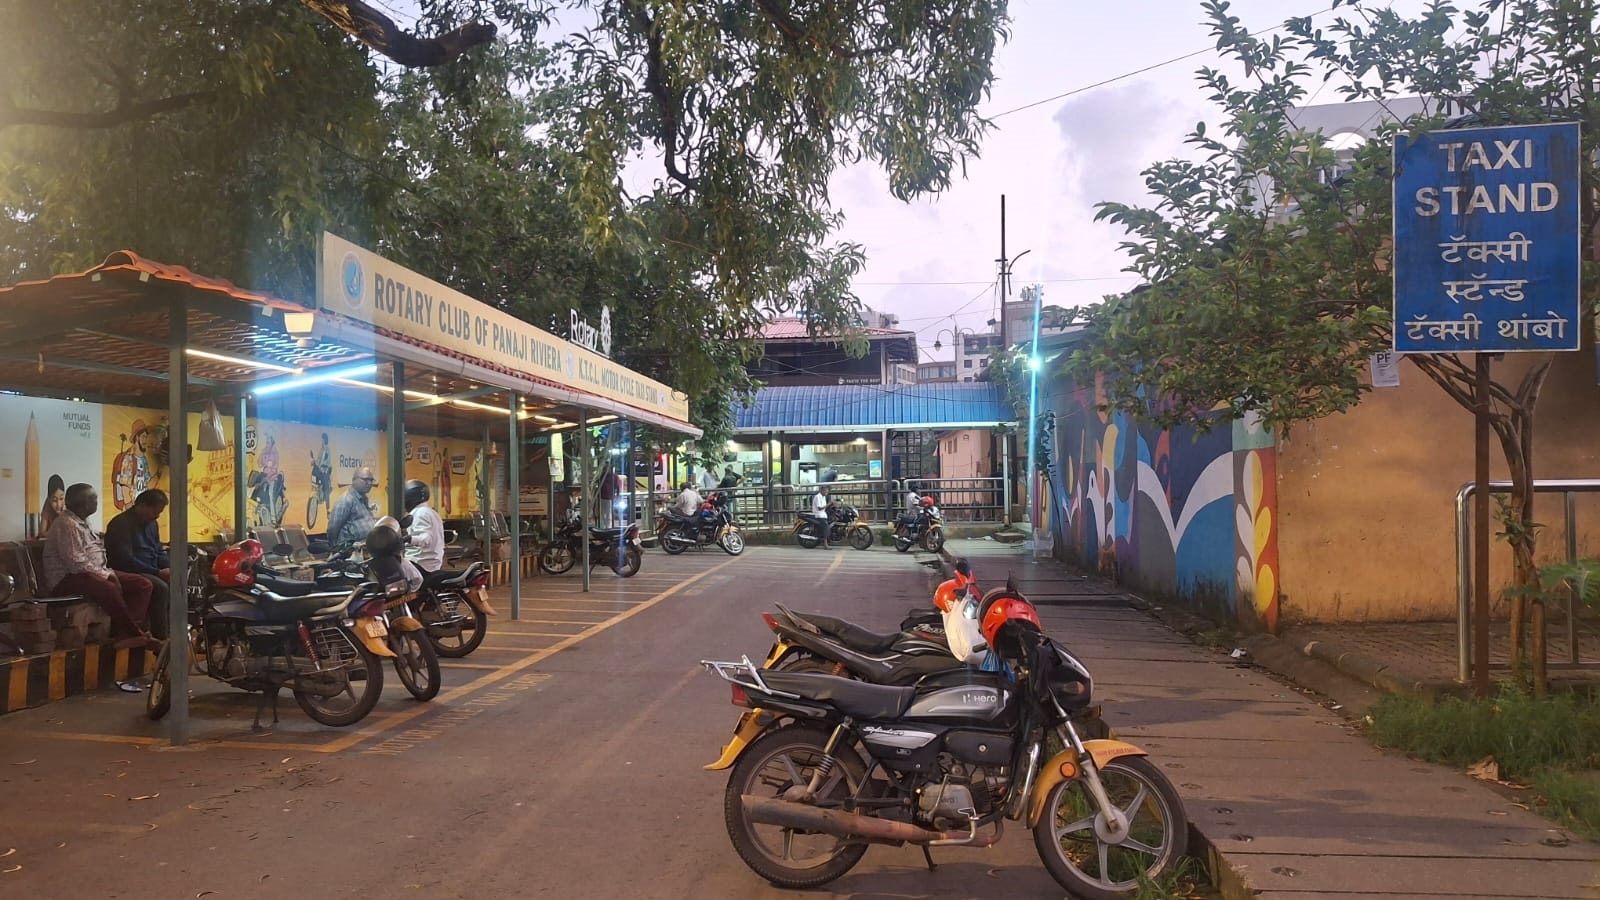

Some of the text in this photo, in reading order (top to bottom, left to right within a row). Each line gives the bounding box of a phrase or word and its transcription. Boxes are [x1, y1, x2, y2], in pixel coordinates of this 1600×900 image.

[1438, 139, 1532, 172] TAXI
[1414, 182, 1559, 217] STAND
[1437, 231, 1533, 263] टॅक्सी
[374, 271, 433, 328] ROTARY
[438, 301, 471, 341] CLUB
[474, 315, 489, 347] OF
[492, 322, 528, 361] PANAJI
[530, 337, 562, 373] RIVIERA
[570, 308, 599, 351] Rotary
[1403, 310, 1568, 341] टॅक्सी थांबो
[601, 367, 619, 392] MOTOR
[619, 374, 634, 397] CYCLE
[63, 412, 91, 422] MUTUAL
[69, 421, 91, 431] FUNDS
[973, 694, 997, 703] Hero
